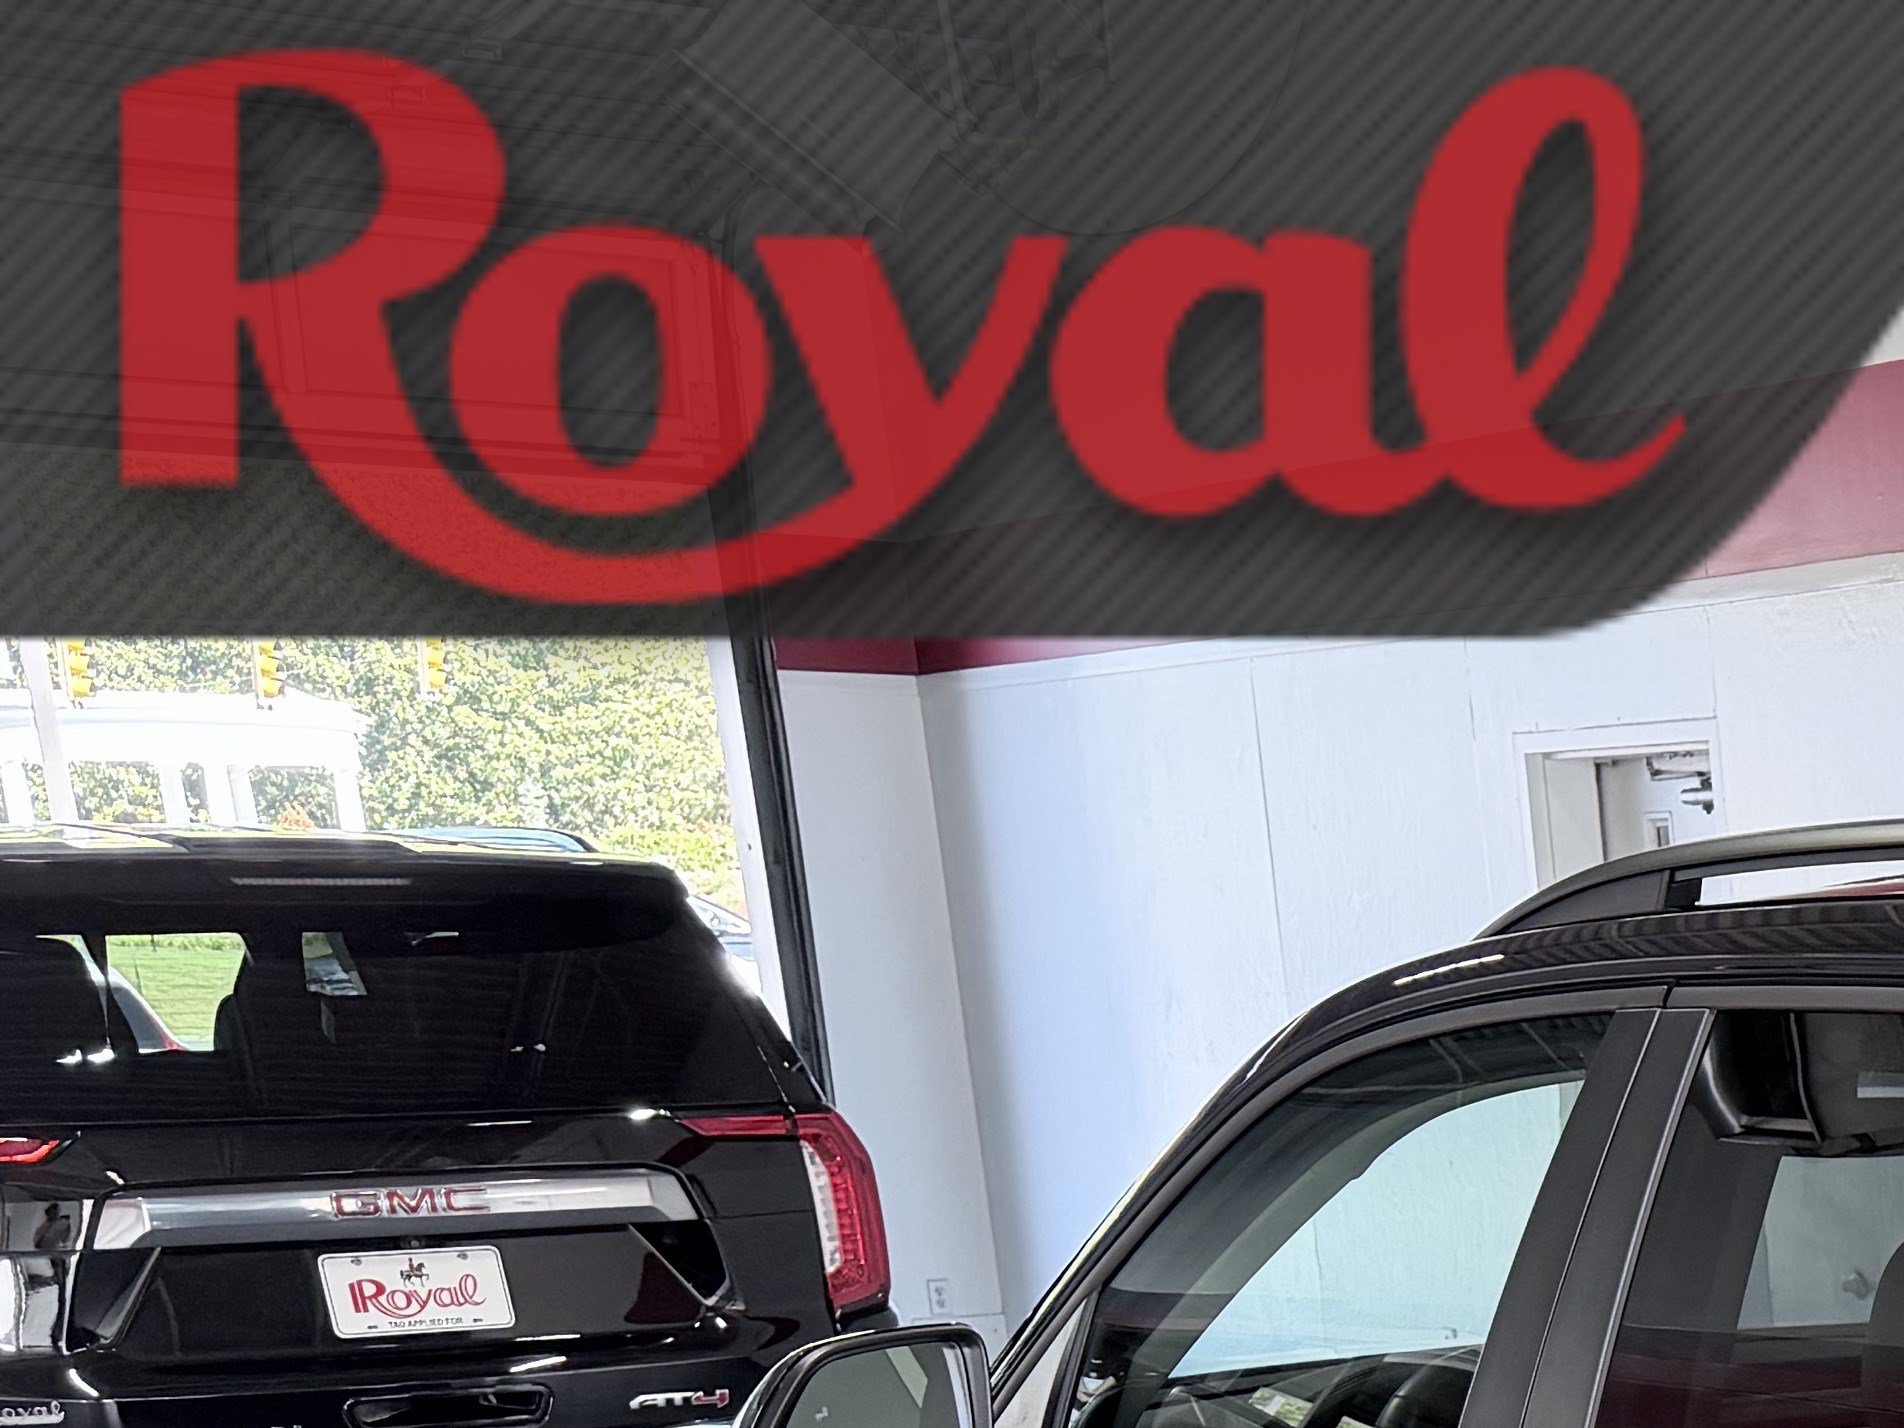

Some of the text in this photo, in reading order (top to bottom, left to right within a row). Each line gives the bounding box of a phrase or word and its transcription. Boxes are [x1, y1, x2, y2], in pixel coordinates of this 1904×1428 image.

[329, 1184, 491, 1219] GMC
[348, 1273, 487, 1319] Royal
[0, 1400, 65, 1426] oyal
